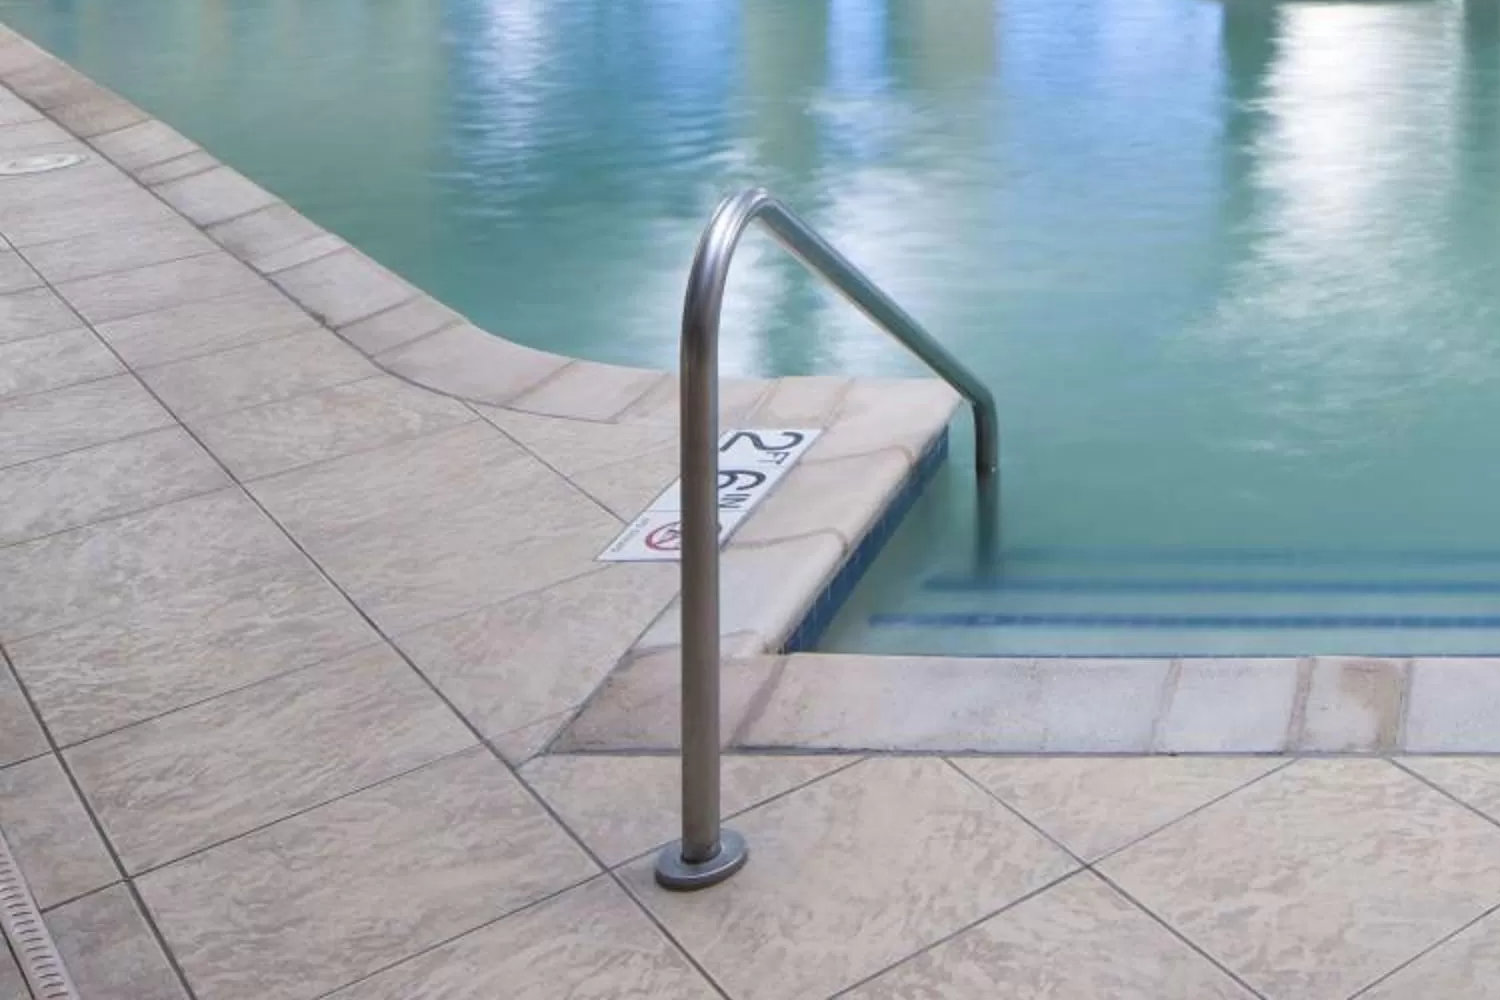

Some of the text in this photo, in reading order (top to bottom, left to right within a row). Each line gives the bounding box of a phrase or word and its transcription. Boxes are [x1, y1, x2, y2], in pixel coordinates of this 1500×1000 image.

[718, 431, 804, 508] 2 FT 6 IN
